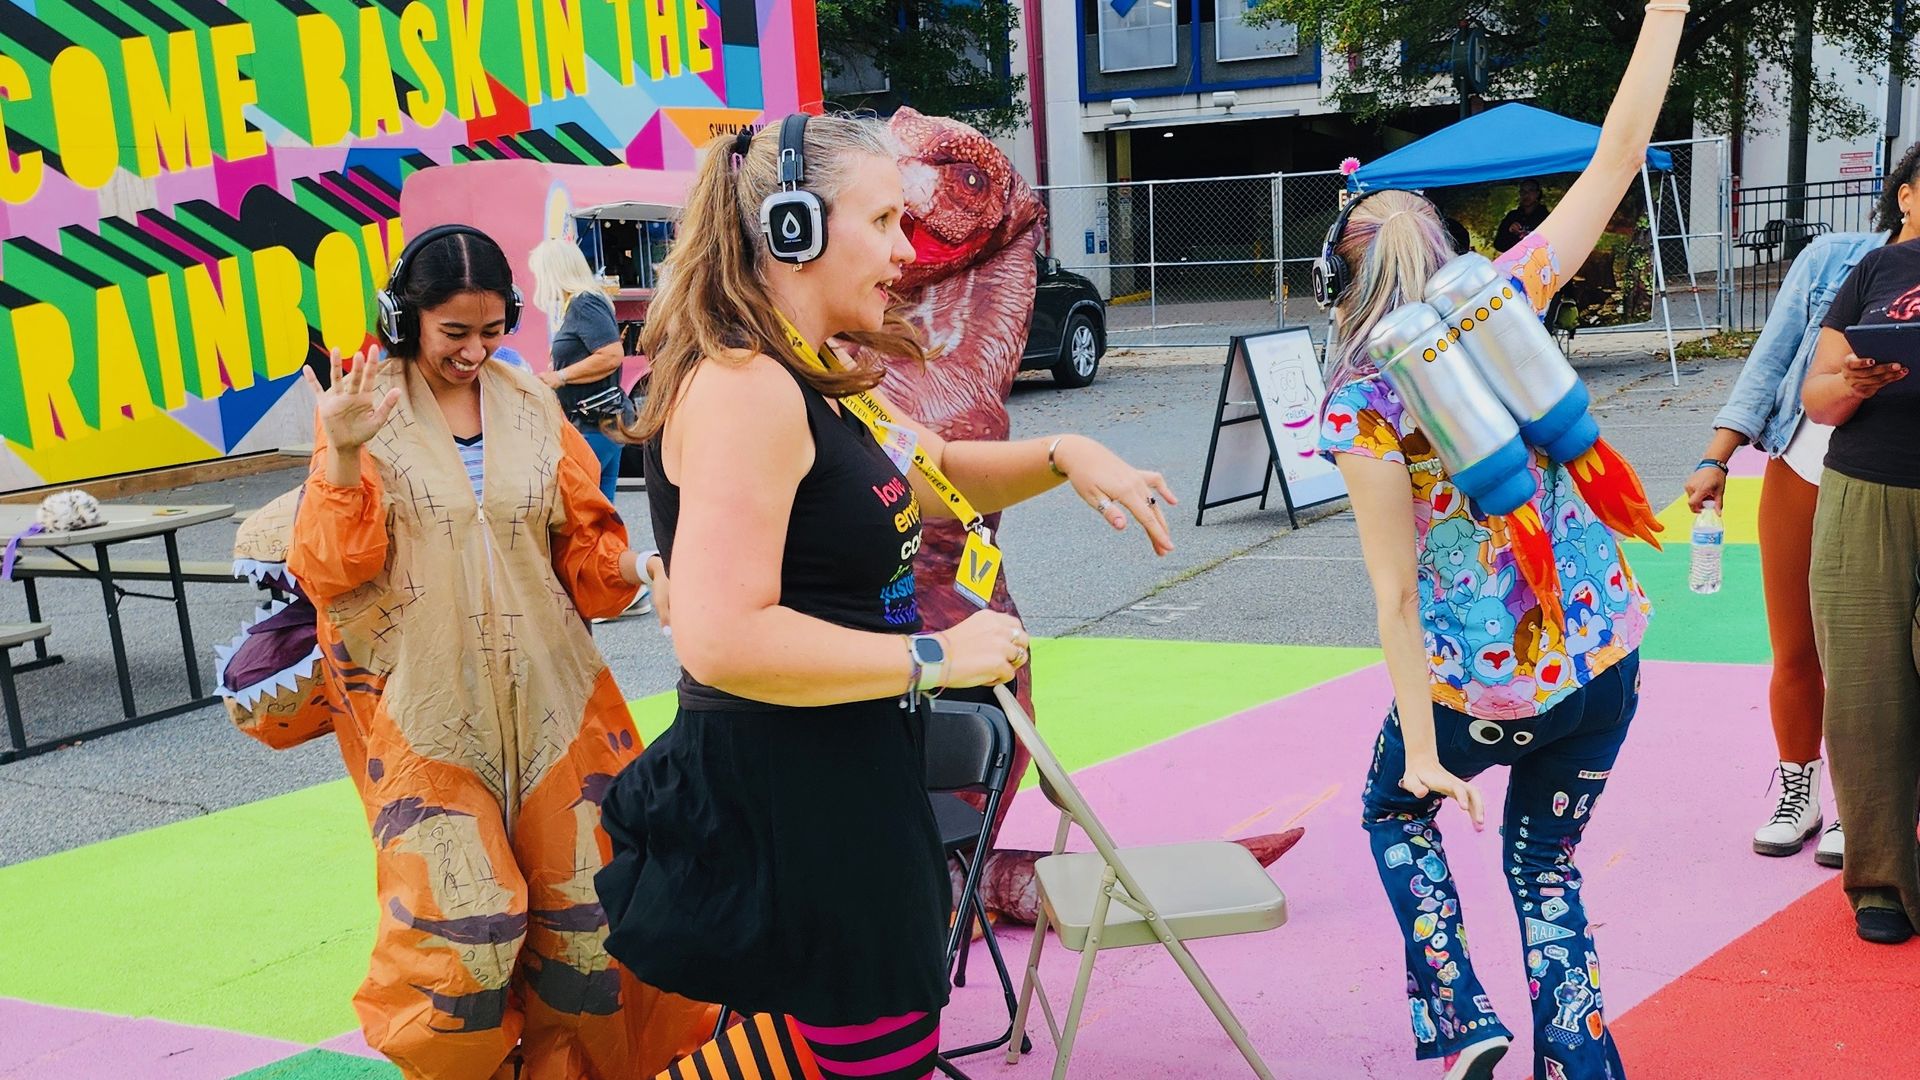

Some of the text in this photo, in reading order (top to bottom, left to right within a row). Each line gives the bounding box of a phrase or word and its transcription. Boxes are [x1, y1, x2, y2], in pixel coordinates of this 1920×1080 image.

[0, 0, 713, 205] COME BASK IN THE
[1389, 847, 1406, 860] OK
[1531, 925, 1556, 941] RAD
